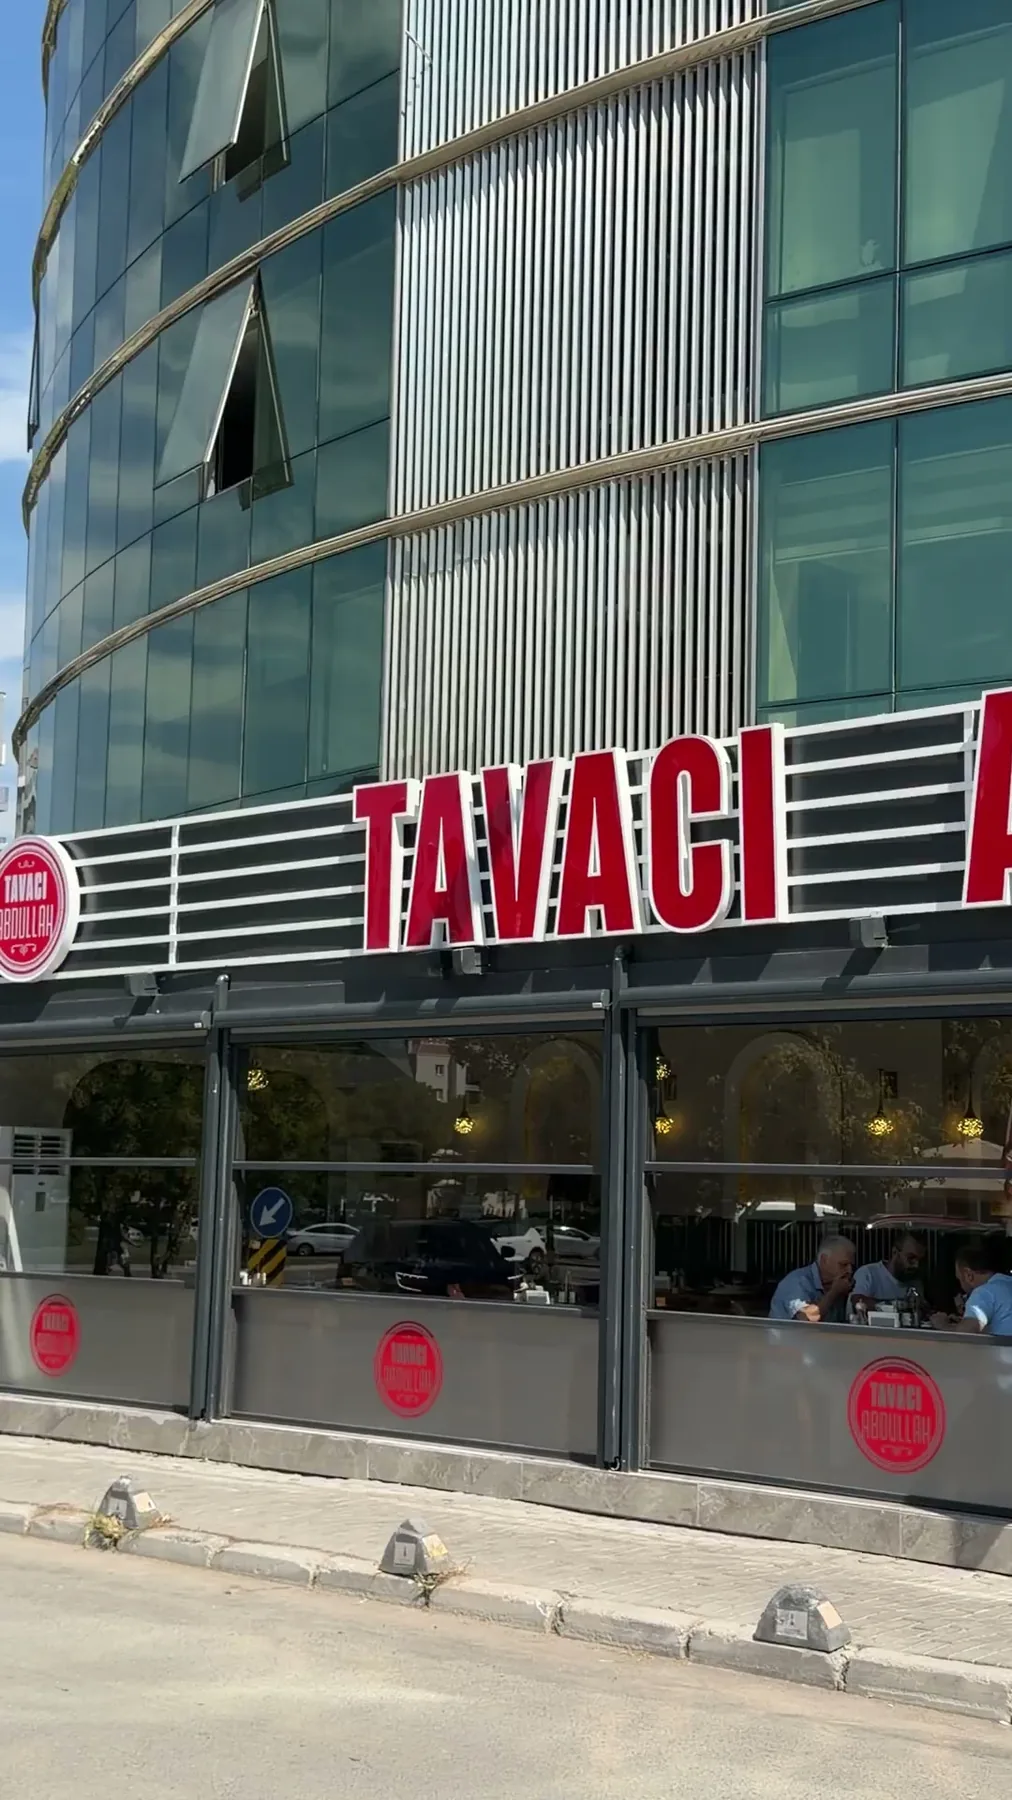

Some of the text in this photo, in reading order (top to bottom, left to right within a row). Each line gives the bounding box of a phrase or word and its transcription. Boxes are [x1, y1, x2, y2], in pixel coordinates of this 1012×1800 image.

[353, 723, 787, 952] TAVACI
[4, 871, 47, 904] TAVACI
[870, 1382, 922, 1411] TAVACI
